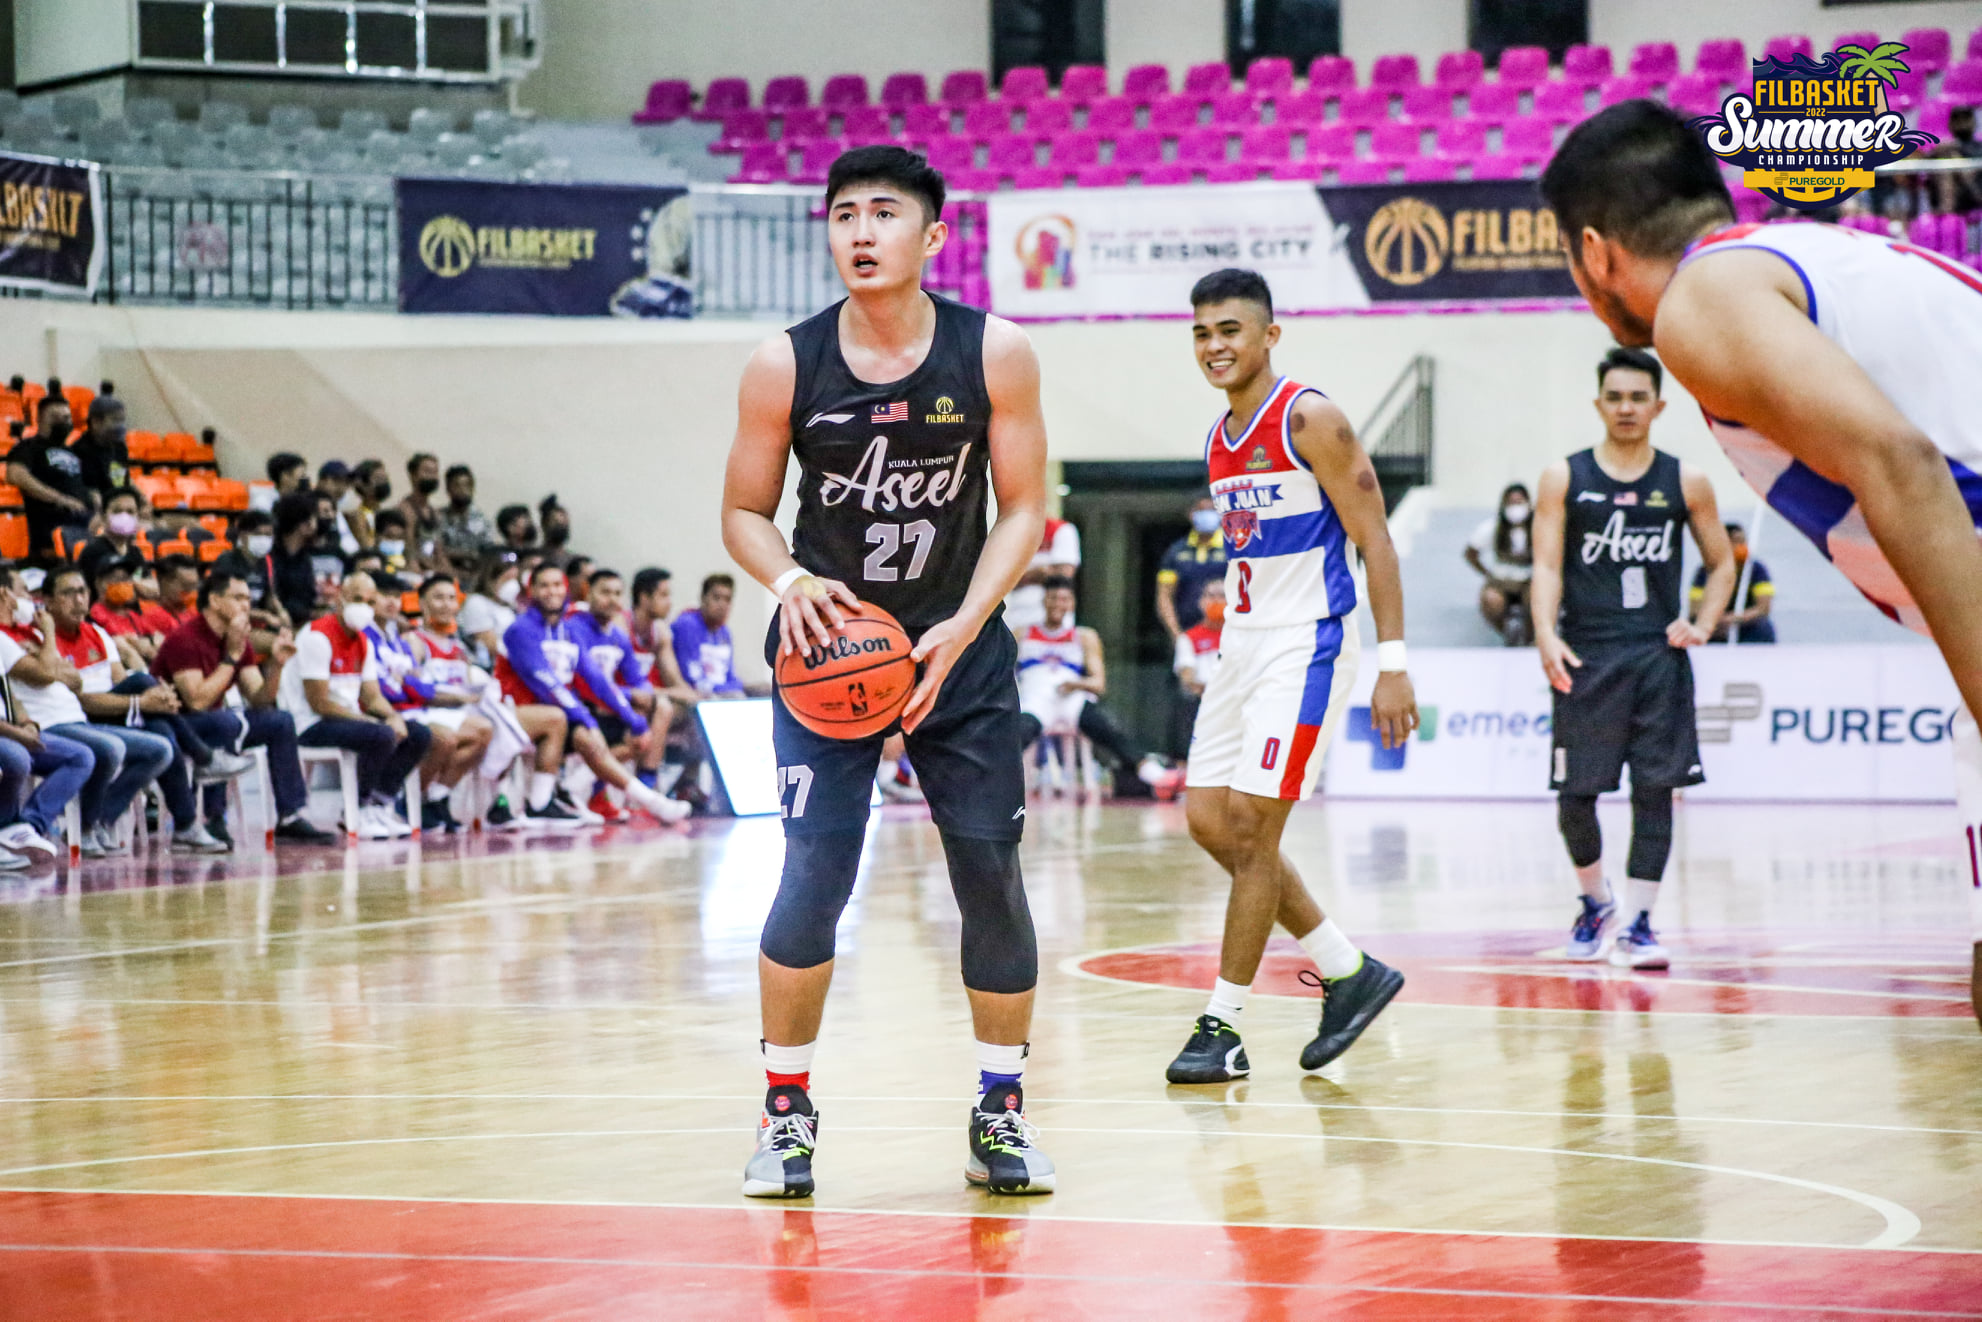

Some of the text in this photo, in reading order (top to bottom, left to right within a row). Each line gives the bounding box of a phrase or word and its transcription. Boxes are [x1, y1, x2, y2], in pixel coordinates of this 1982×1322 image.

[1453, 208, 1559, 254] FILBA
[1150, 240, 1241, 261] RISING
[1250, 238, 1312, 258] CITY
[926, 414, 965, 424] FILBASKET
[819, 436, 972, 513] Aseel
[888, 455, 954, 469] KUALA LUMPUR
[1234, 488, 1271, 510] JUAN
[863, 519, 936, 581] 27
[803, 635, 893, 671] Wilson
[1261, 737, 1280, 770] 0
